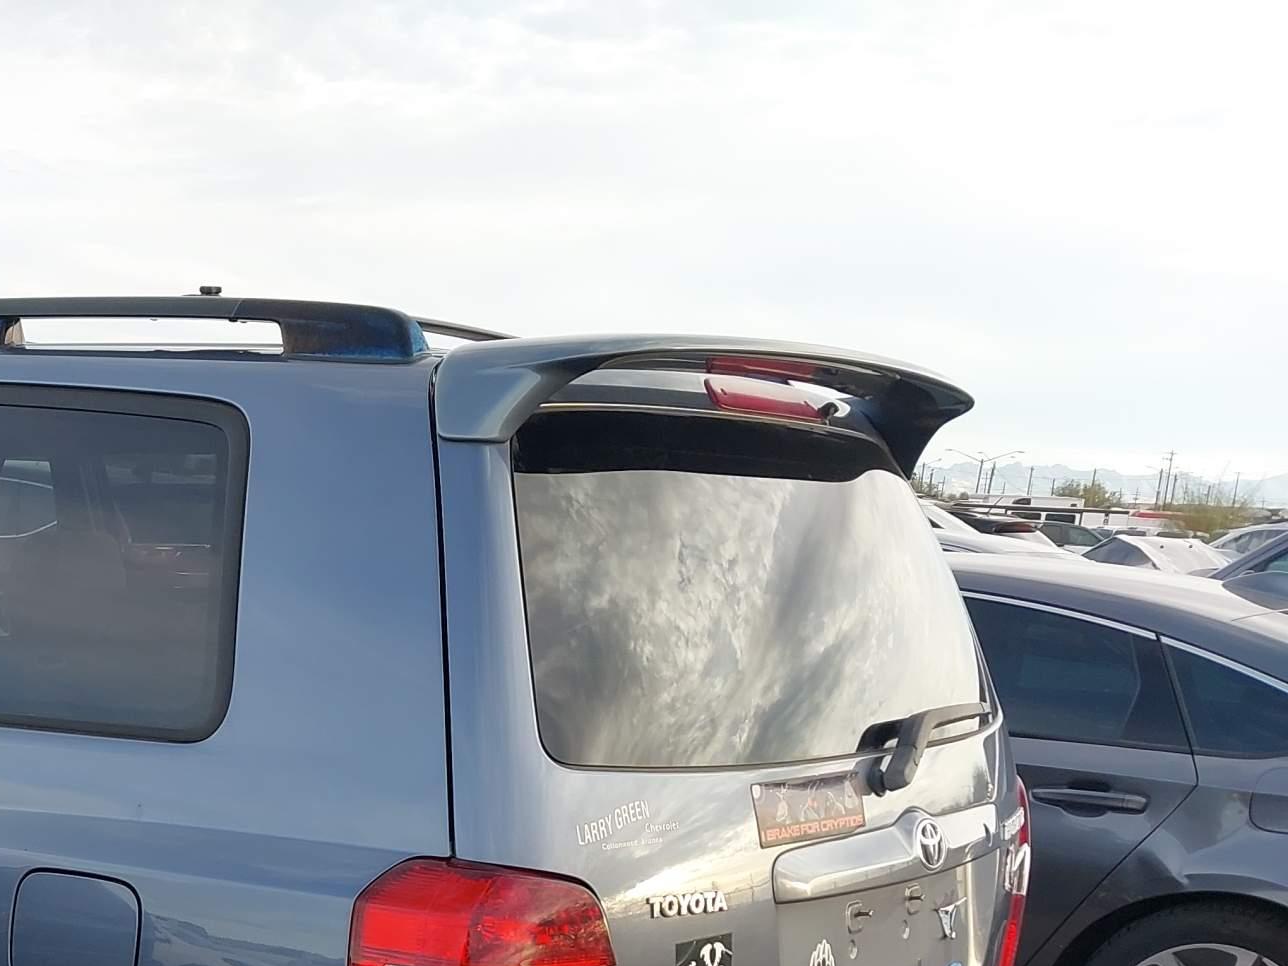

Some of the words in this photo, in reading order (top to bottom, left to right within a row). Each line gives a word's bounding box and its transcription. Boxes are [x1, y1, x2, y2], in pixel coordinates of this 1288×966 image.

[576, 813, 613, 846] LARRY
[614, 798, 650, 830] GREEN
[766, 824, 801, 841] BRAKE
[800, 821, 820, 835] FOR
[820, 814, 864, 832] CRYPTIDS
[646, 891, 729, 919] TOYOTA
